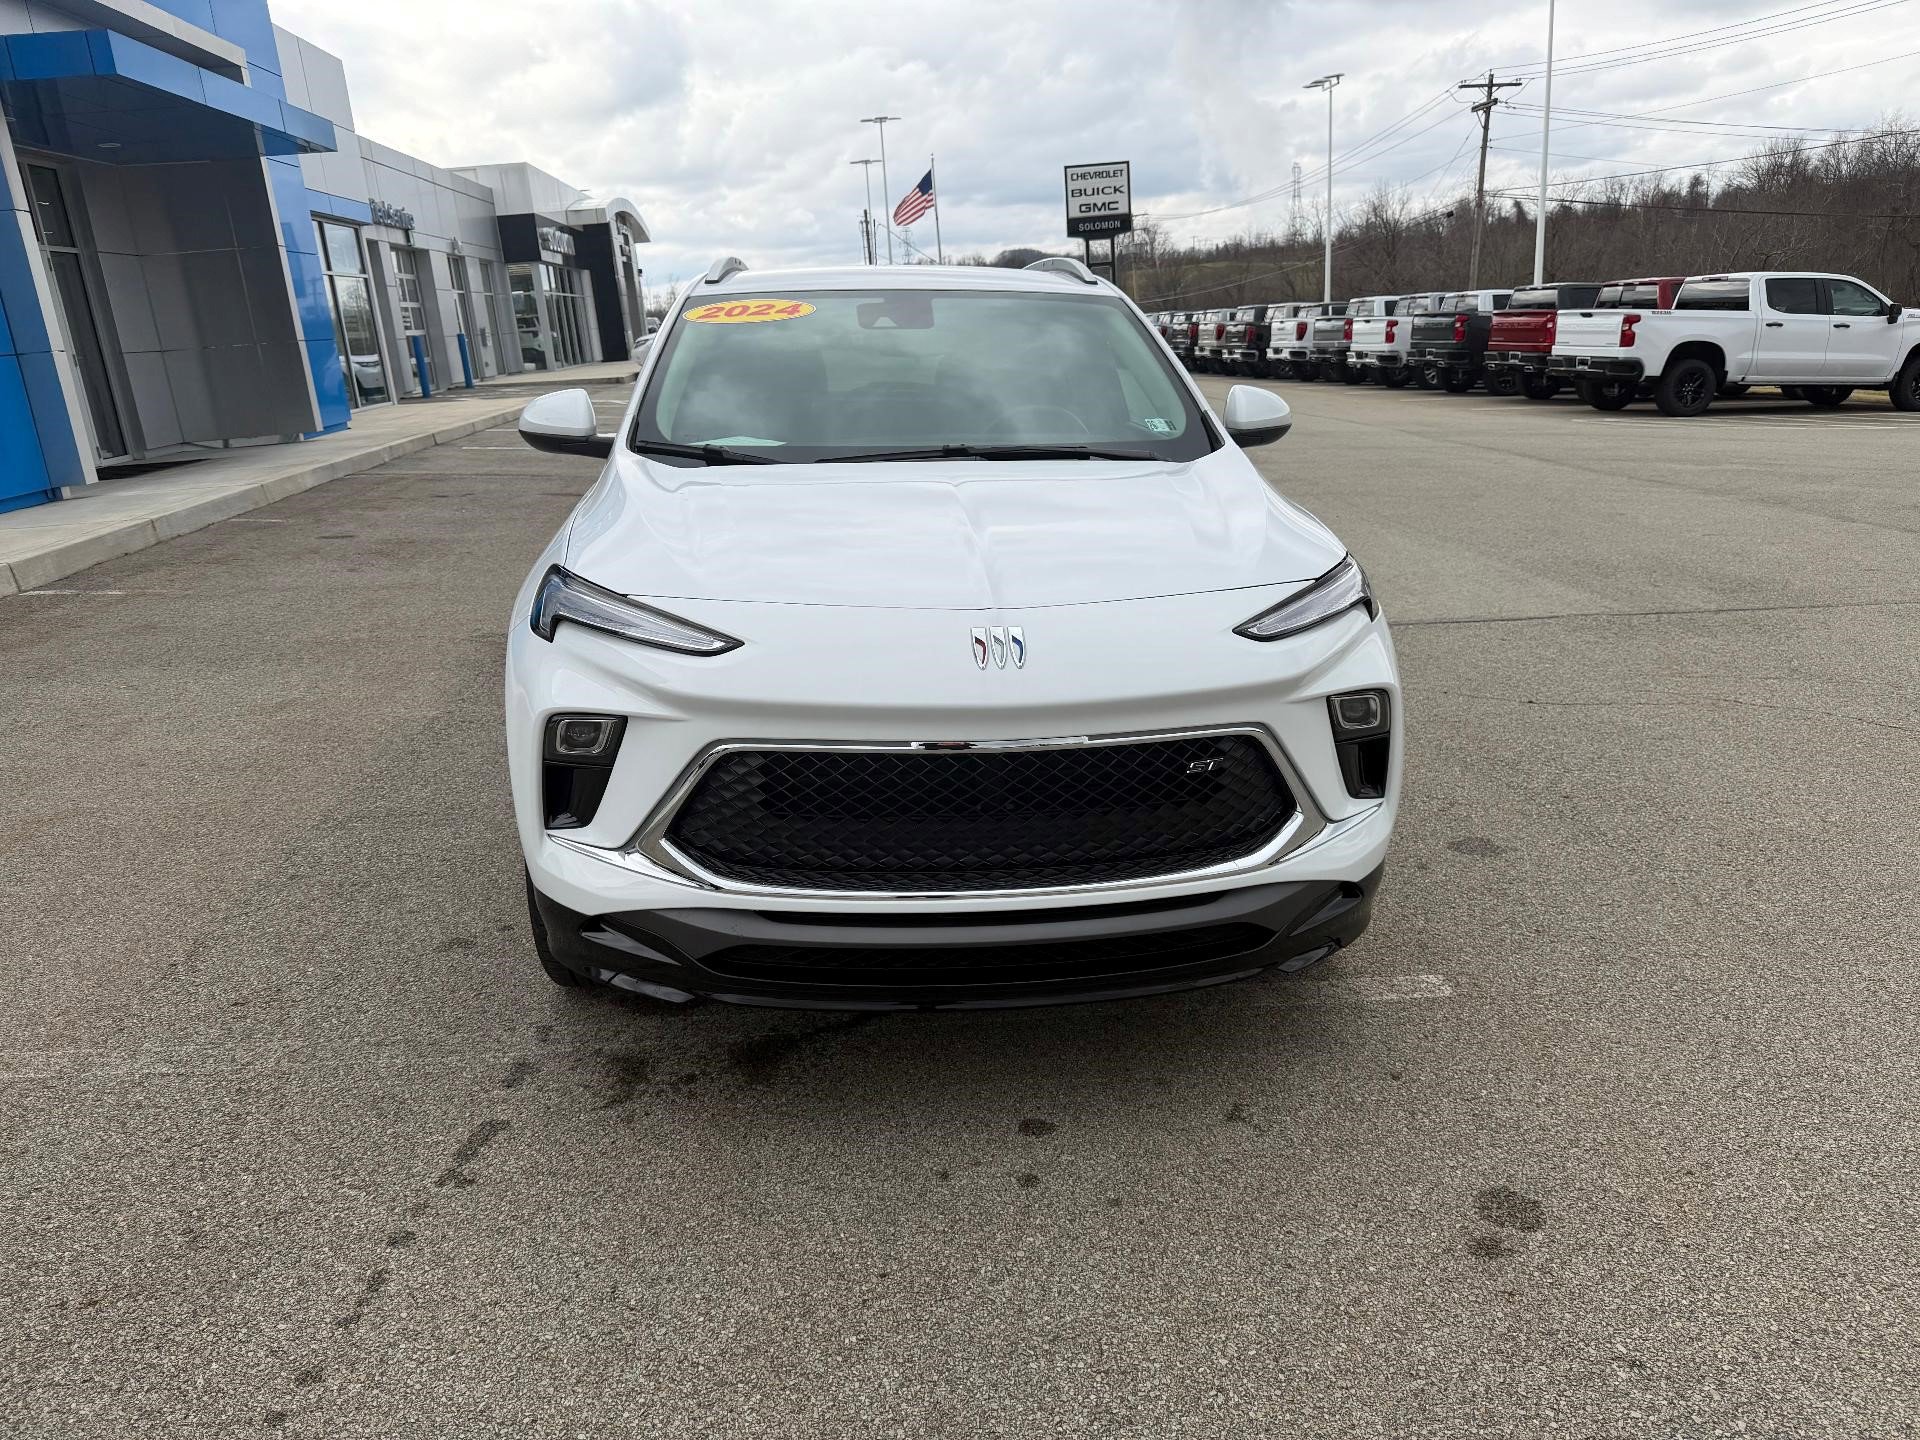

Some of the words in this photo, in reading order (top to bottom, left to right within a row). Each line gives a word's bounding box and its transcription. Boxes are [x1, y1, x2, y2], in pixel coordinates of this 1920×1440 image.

[1070, 169, 1124, 181] CHEVROLET
[1071, 185, 1125, 198] BUICK
[1079, 201, 1119, 213] GMC
[1078, 221, 1121, 232] SOLOMON
[695, 304, 802, 320] 2024
[1186, 757, 1224, 774] ST
